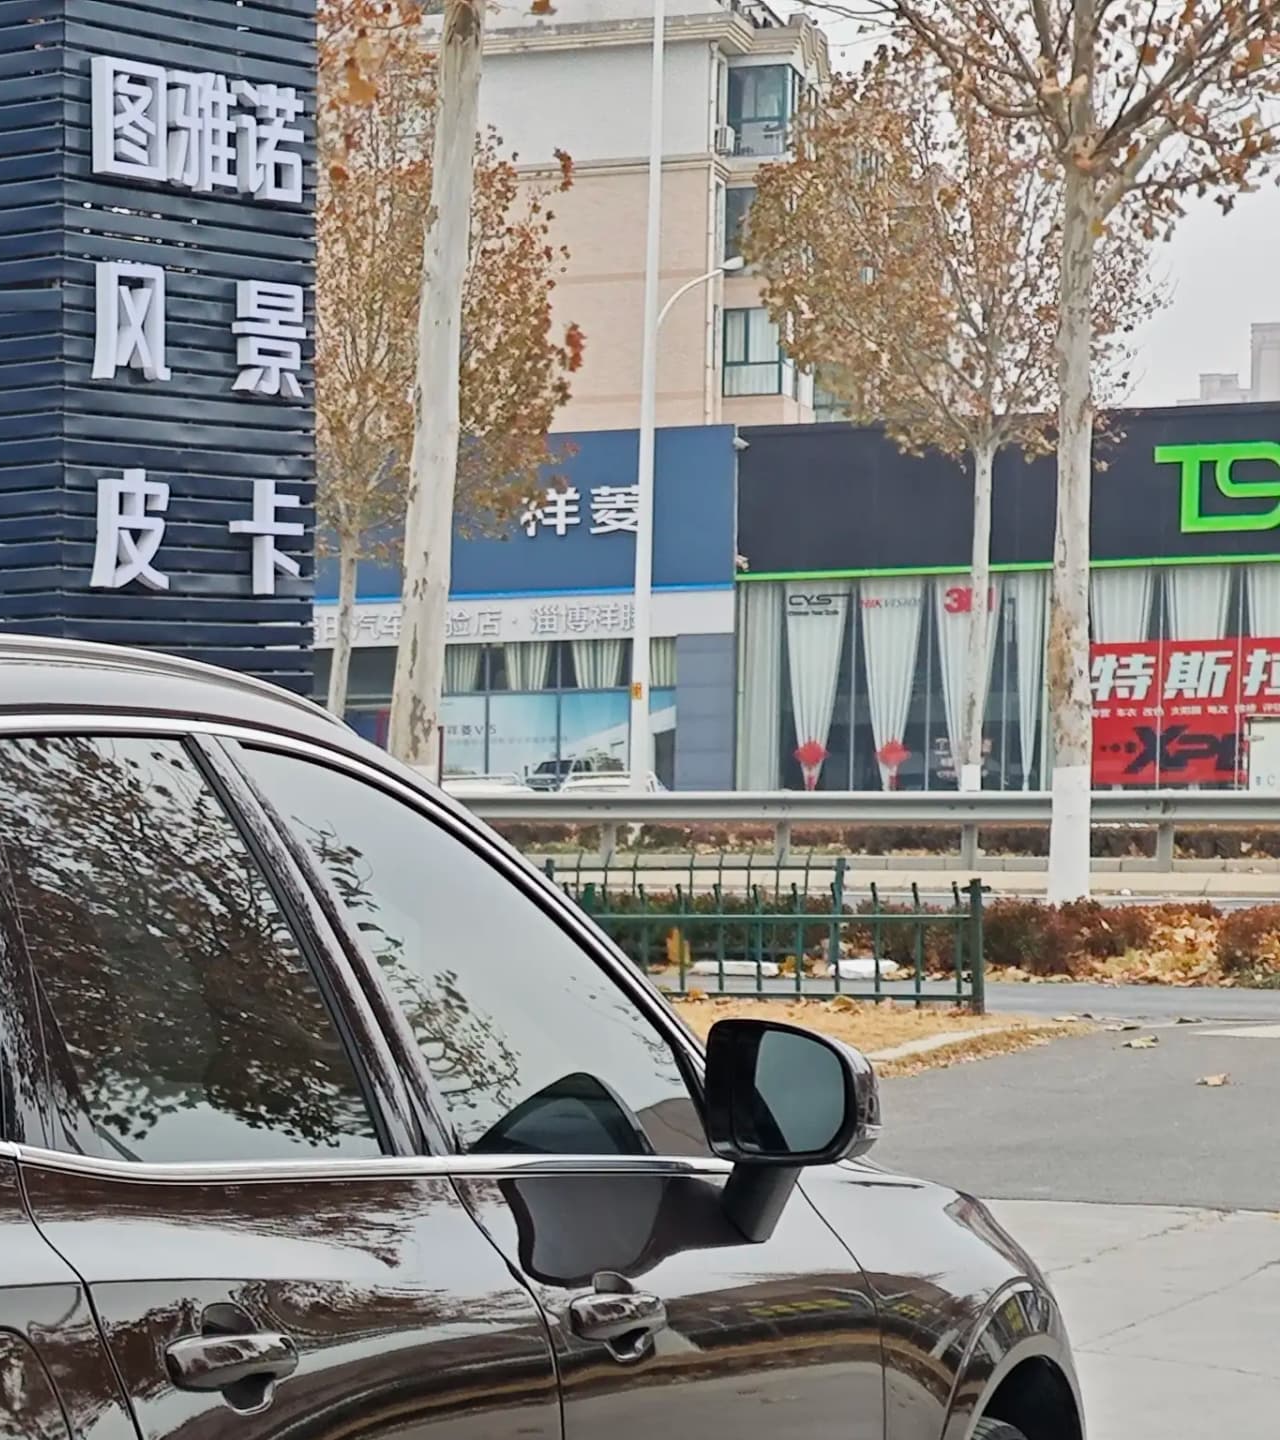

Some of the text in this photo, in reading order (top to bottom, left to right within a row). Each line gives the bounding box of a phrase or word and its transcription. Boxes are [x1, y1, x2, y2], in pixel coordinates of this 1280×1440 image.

[92, 56, 304, 204] 图雅诺
[92, 261, 307, 399] 风景
[90, 468, 305, 596] 皮卡
[520, 485, 638, 537] 祥菱
